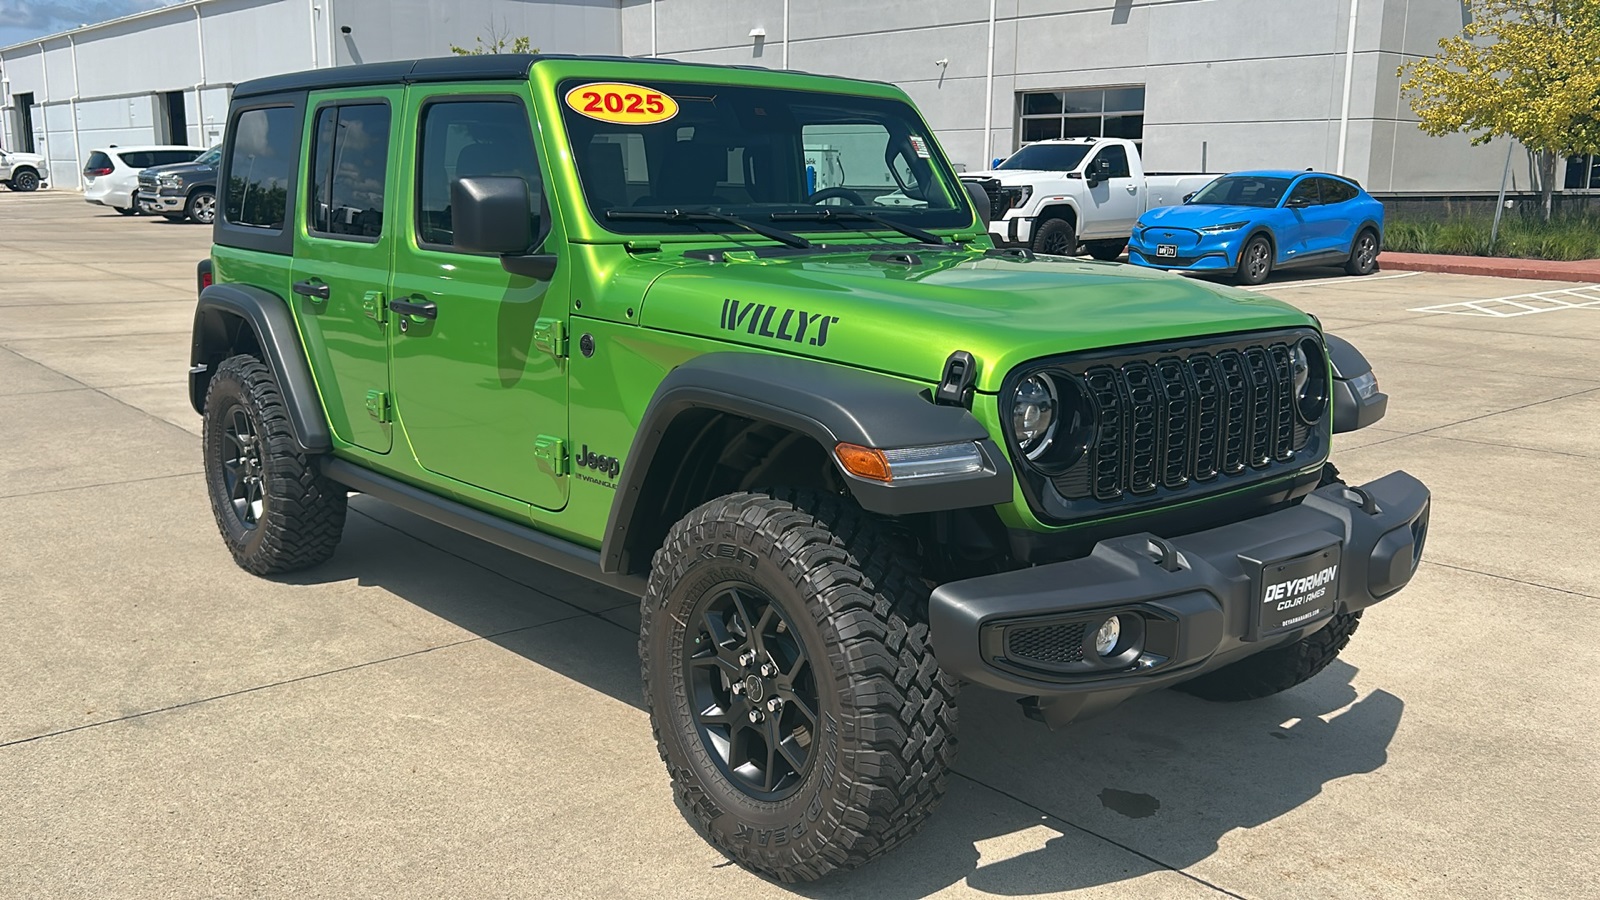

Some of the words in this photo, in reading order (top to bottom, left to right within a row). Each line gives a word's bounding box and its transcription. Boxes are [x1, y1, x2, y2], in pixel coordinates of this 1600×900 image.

[582, 92, 665, 114] 2025
[720, 298, 840, 347] WILLYS
[575, 444, 620, 479] Jeep
[582, 474, 618, 489] WRANGLE
[659, 542, 760, 610] FALKEN
[1263, 565, 1337, 603] DEYARMAN
[1277, 596, 1303, 611] CDJR
[1305, 587, 1326, 603] AMES
